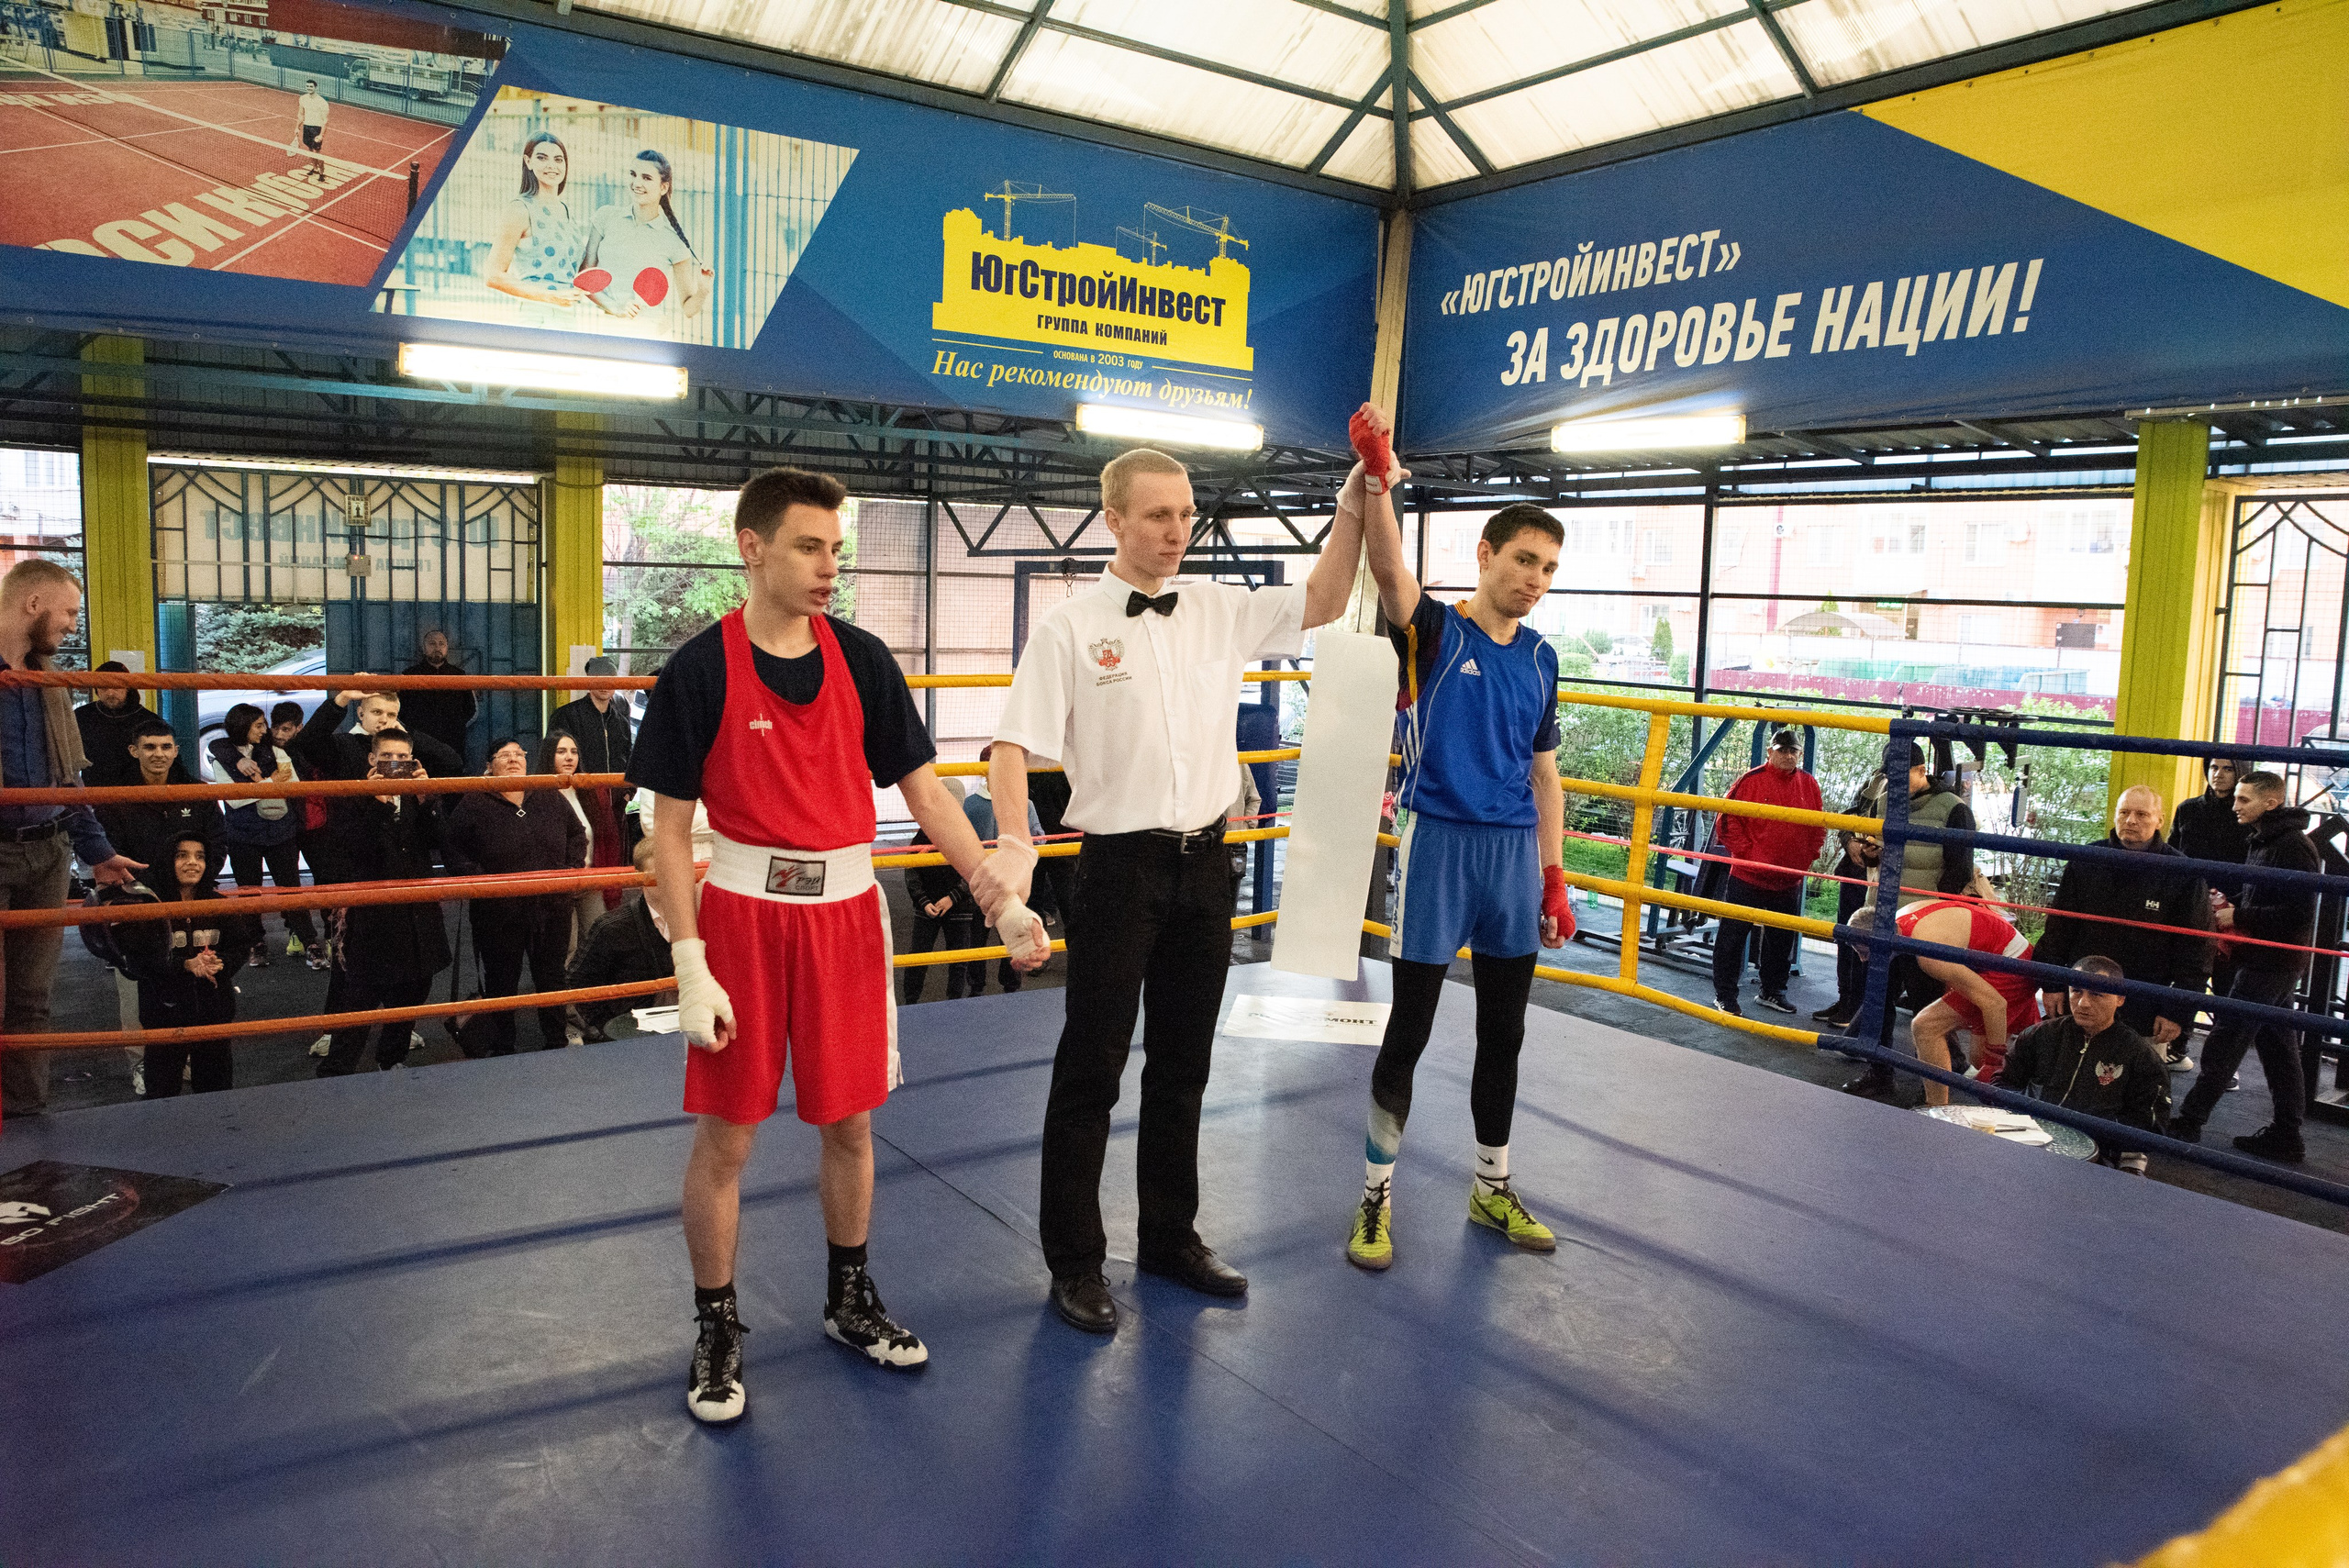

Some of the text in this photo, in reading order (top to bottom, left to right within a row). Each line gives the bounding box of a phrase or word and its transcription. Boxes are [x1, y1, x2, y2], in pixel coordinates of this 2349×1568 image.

[1440, 228, 1742, 316] «ЮГСТРОЙИНВЕСТ»
[971, 250, 1226, 328] ЮгСтройИнвест
[1037, 314, 1168, 347] ГРУППА КОМПАНИЙ
[1500, 258, 2045, 389] ЗА ЗДОРОВЬЕ НАЦИИ!
[1053, 350, 1088, 362] ОСНОВАНА
[1097, 354, 1125, 367] 2003
[931, 350, 1252, 410] Нас рекомендуют друзьям!
[1098, 672, 1128, 680] ФЕДЕРАЦИЯ
[1460, 667, 1481, 676] adidas
[46, 1193, 120, 1226] FIGHT
